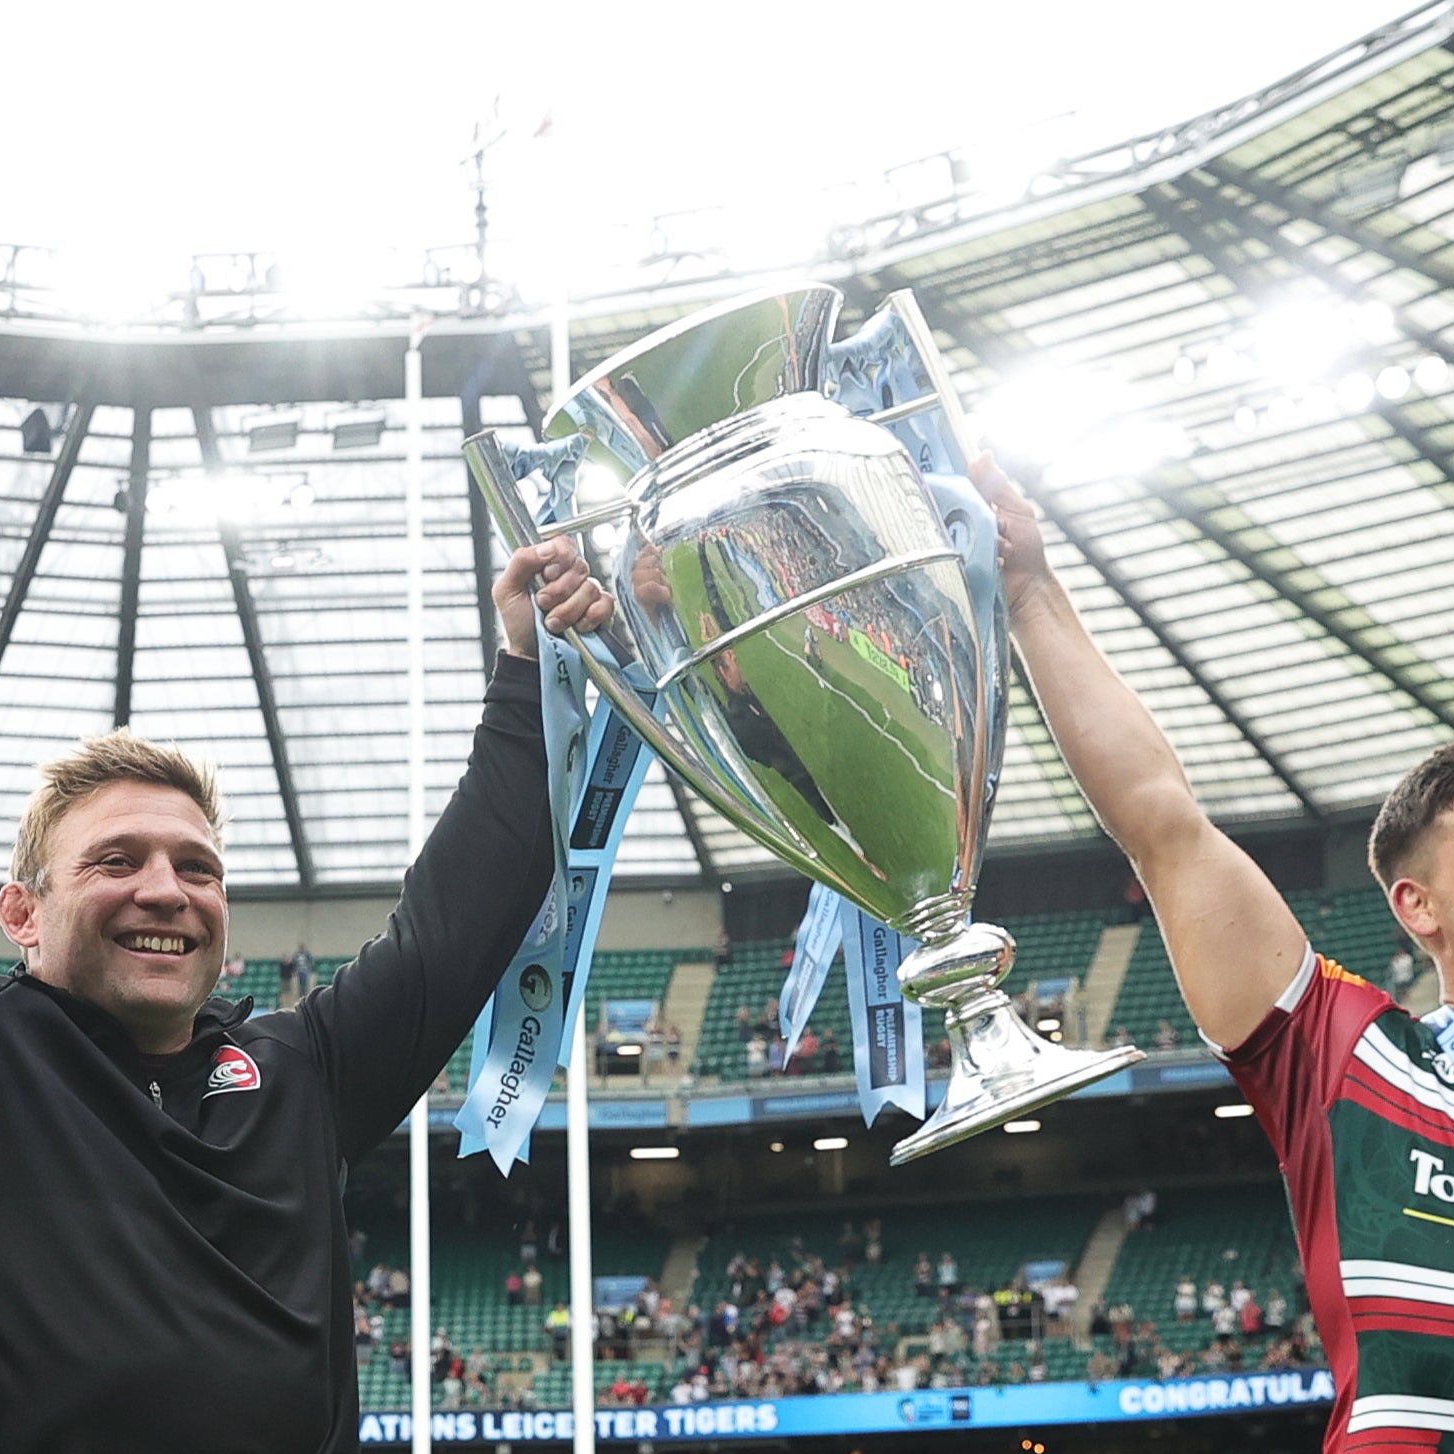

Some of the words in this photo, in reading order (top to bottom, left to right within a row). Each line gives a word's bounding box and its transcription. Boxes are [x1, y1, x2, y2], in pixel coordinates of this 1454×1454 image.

[873, 926, 890, 1000] Gallagher
[874, 1009, 886, 1048] RUGBY
[886, 1008, 898, 1082] PREMIERSHIP
[486, 1015, 542, 1130] Gallagher
[481, 1409, 659, 1440] LEICETER
[663, 1404, 779, 1436] TIGERS
